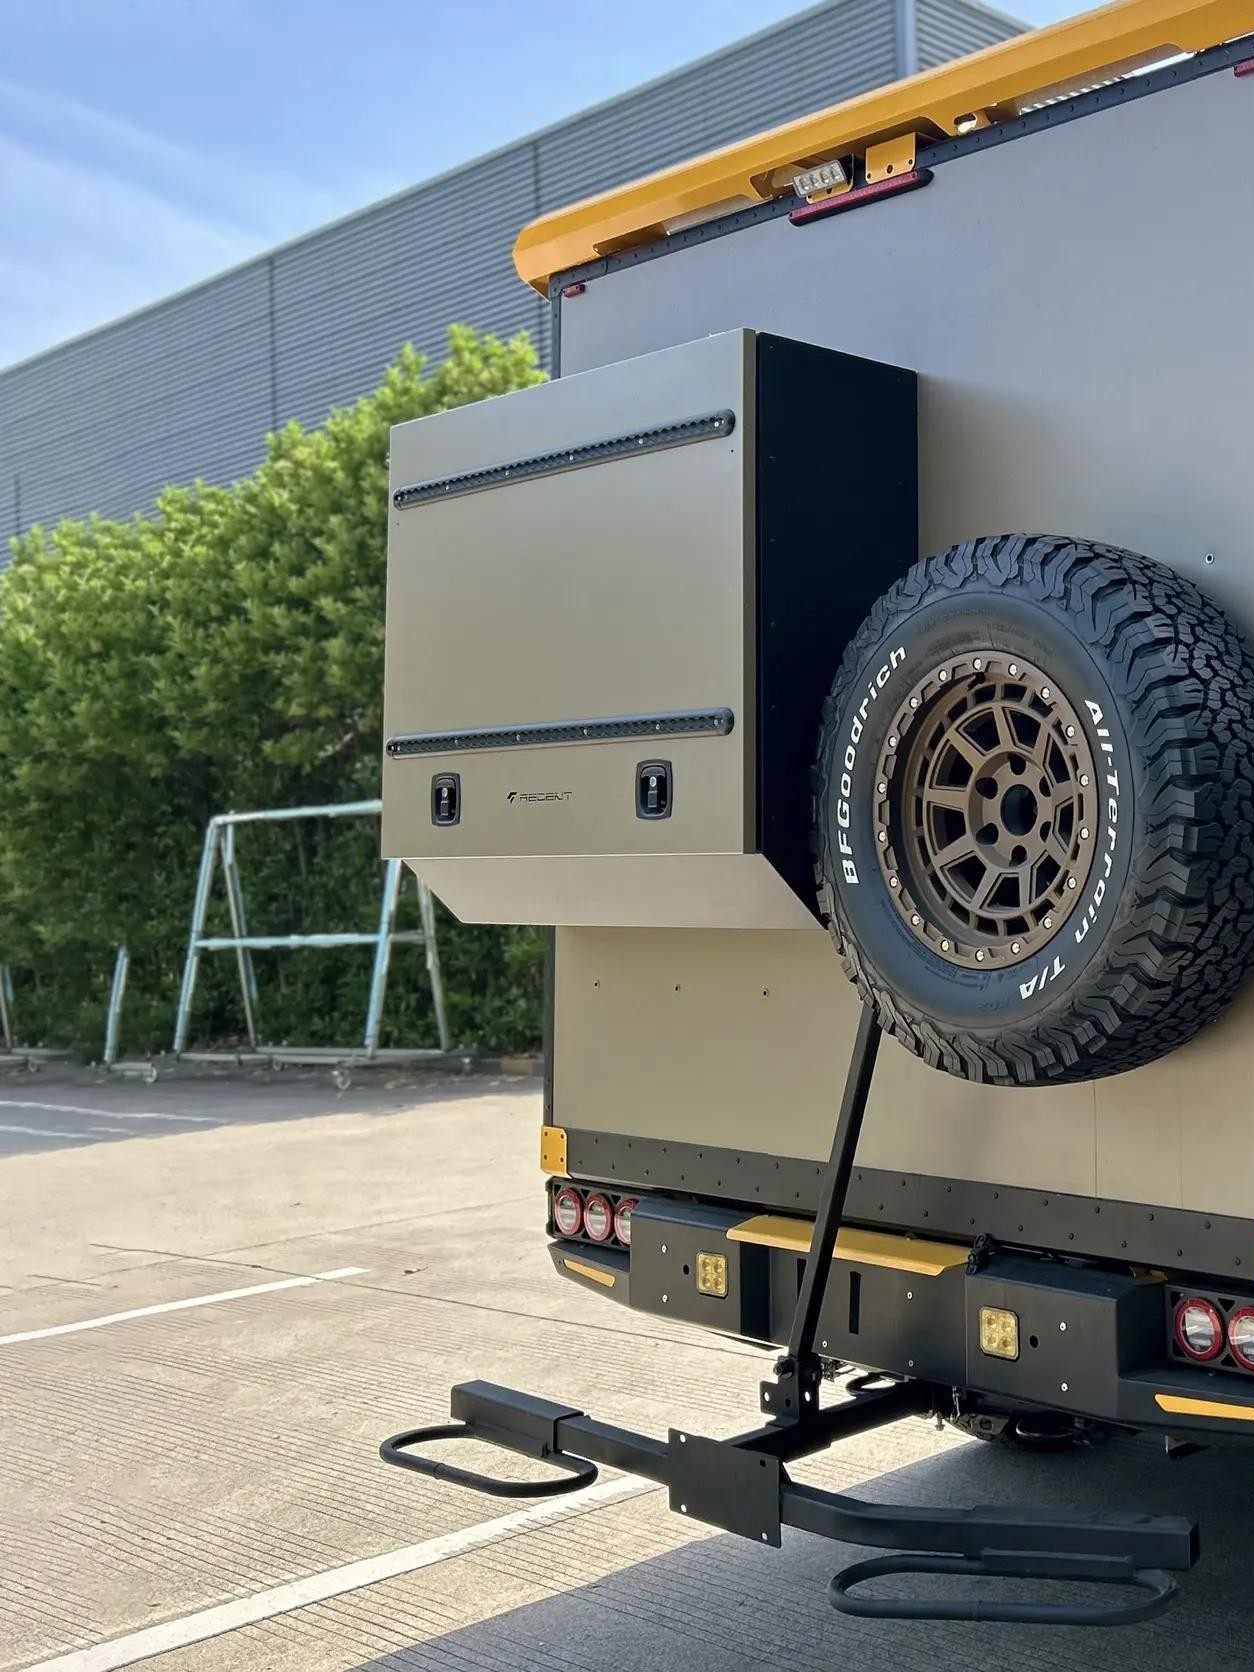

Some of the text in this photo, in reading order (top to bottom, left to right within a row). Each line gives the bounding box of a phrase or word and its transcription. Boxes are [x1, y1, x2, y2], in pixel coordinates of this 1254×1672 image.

[837, 646, 907, 884] BFGoodrich
[1018, 699, 1120, 1000] All-Terrain T/A
